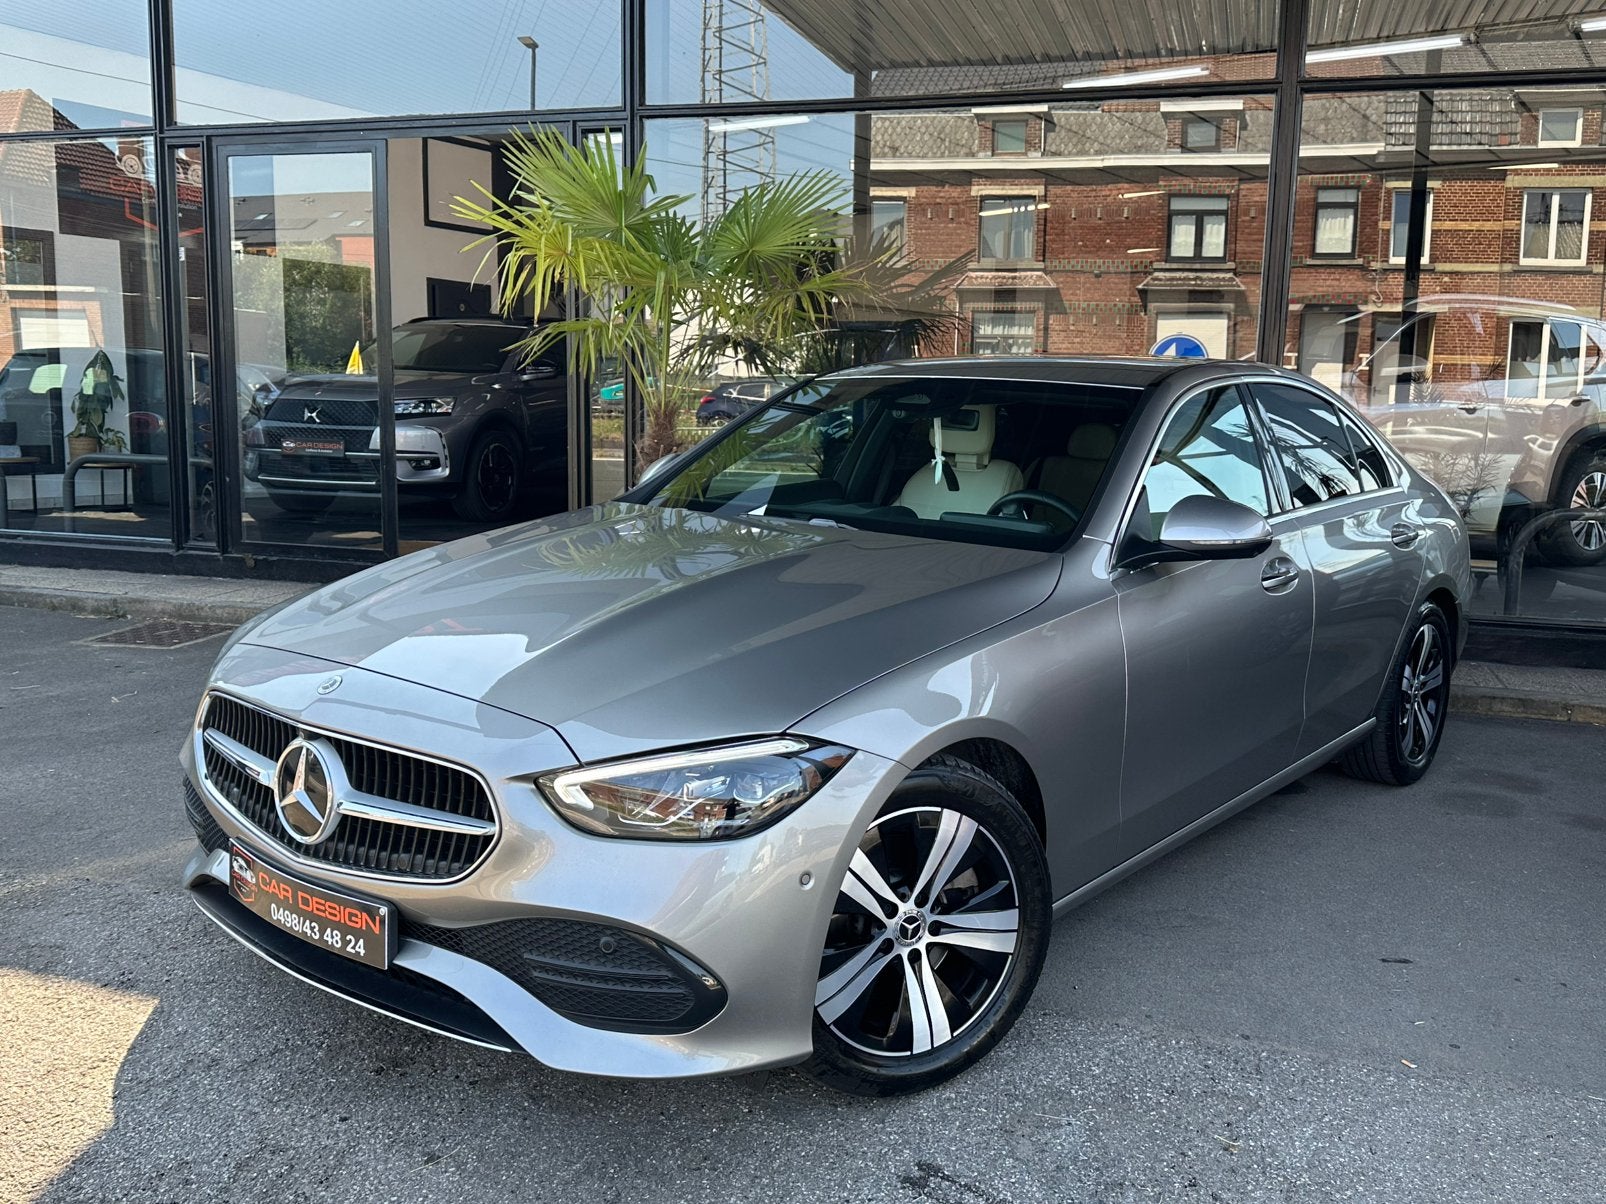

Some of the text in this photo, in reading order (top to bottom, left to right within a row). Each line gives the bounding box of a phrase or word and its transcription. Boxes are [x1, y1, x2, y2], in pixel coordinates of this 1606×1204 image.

[258, 872, 380, 934] CAR DESIGN
[271, 903, 365, 956] 0498/43 48 24
